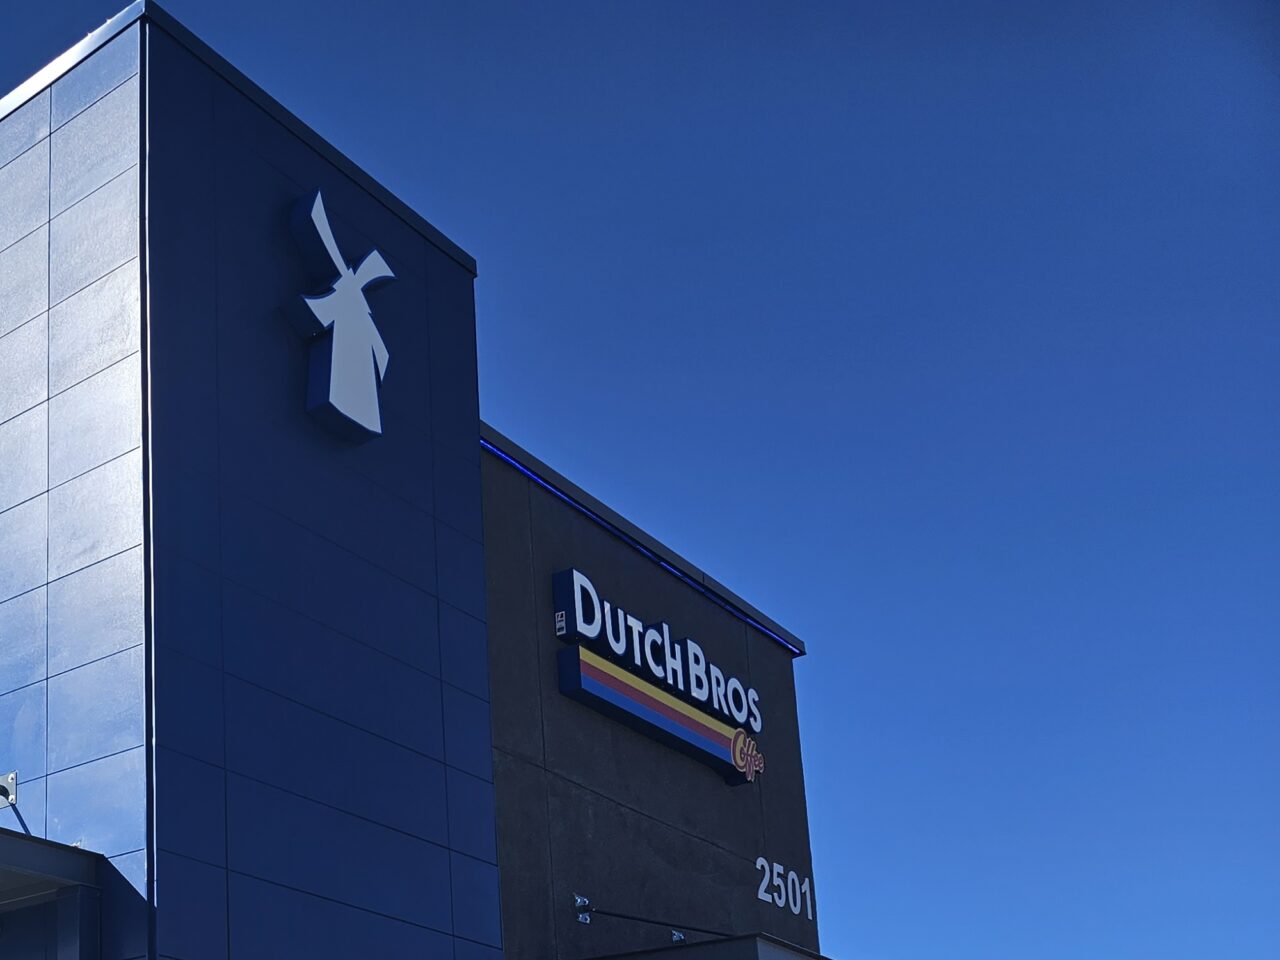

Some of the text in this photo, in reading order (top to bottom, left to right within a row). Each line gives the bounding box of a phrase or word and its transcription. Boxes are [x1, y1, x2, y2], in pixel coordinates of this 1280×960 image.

[572, 568, 763, 733] DUTCH BROS
[730, 728, 765, 782] Coffee
[756, 856, 813, 921] 2501
